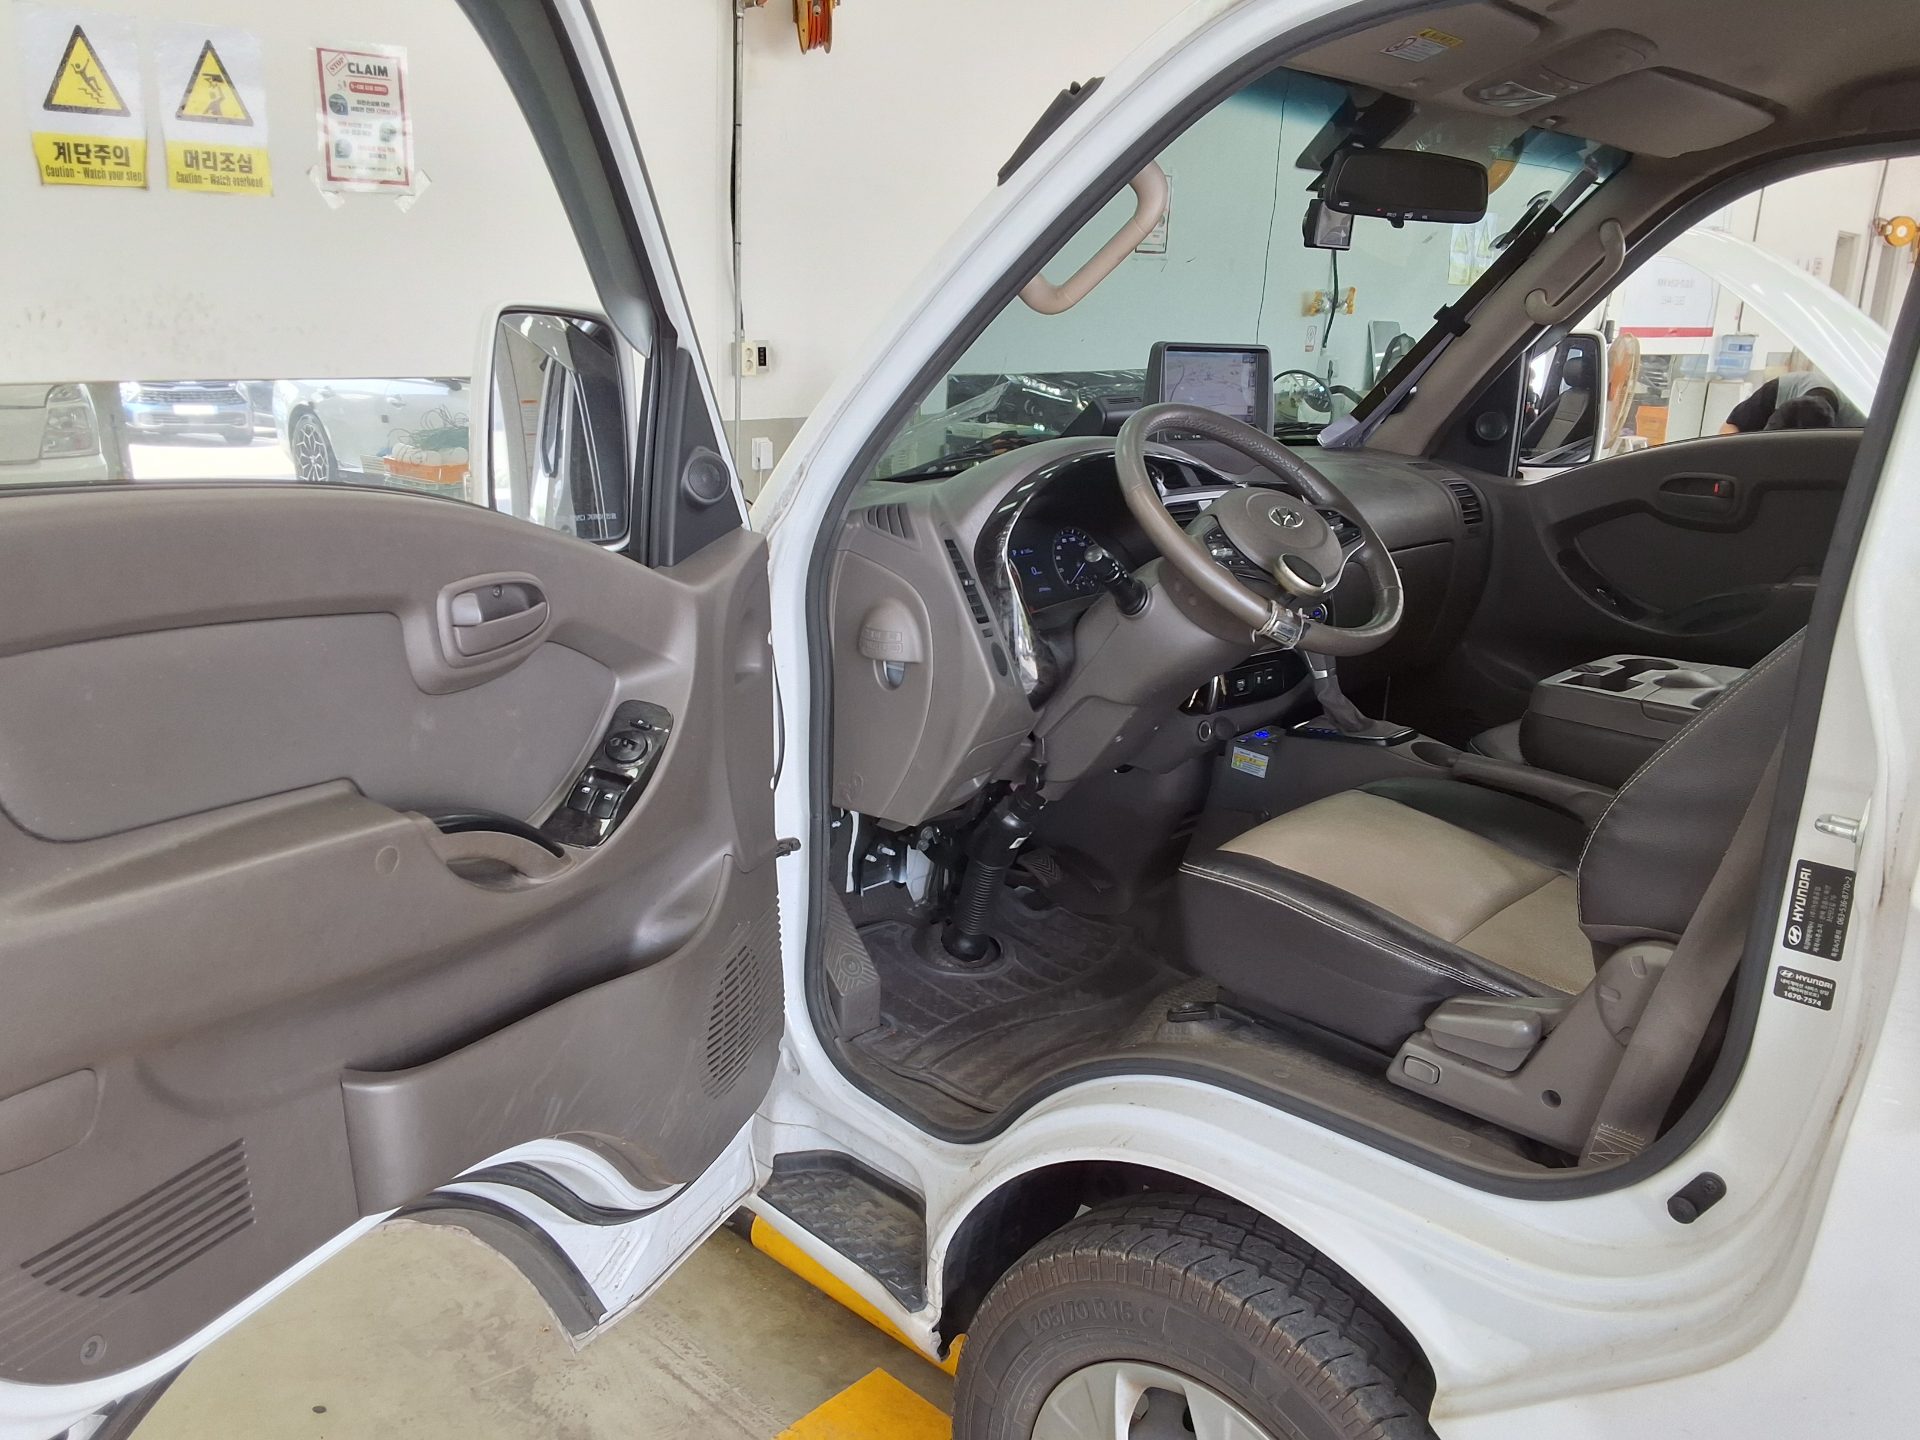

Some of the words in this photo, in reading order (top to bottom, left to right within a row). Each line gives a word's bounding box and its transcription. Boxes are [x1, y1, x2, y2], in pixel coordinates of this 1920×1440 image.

[329, 56, 345, 72] STOP
[347, 62, 389, 77] CLAIM
[52, 141, 131, 167] 계단주의
[183, 149, 253, 174] 머리조심
[45, 164, 76, 178] Caution
[83, 166, 107, 180] Watch
[108, 169, 125, 181] your
[176, 171, 203, 185] Caution
[210, 174, 232, 187] Watch
[1792, 867, 1812, 922] HYUNDAI
[1795, 974, 1833, 990] HYUNDAI
[1784, 991, 1822, 1007] 1670-7574
[1091, 1297, 1108, 1320] R
[1138, 1306, 1155, 1328] C
